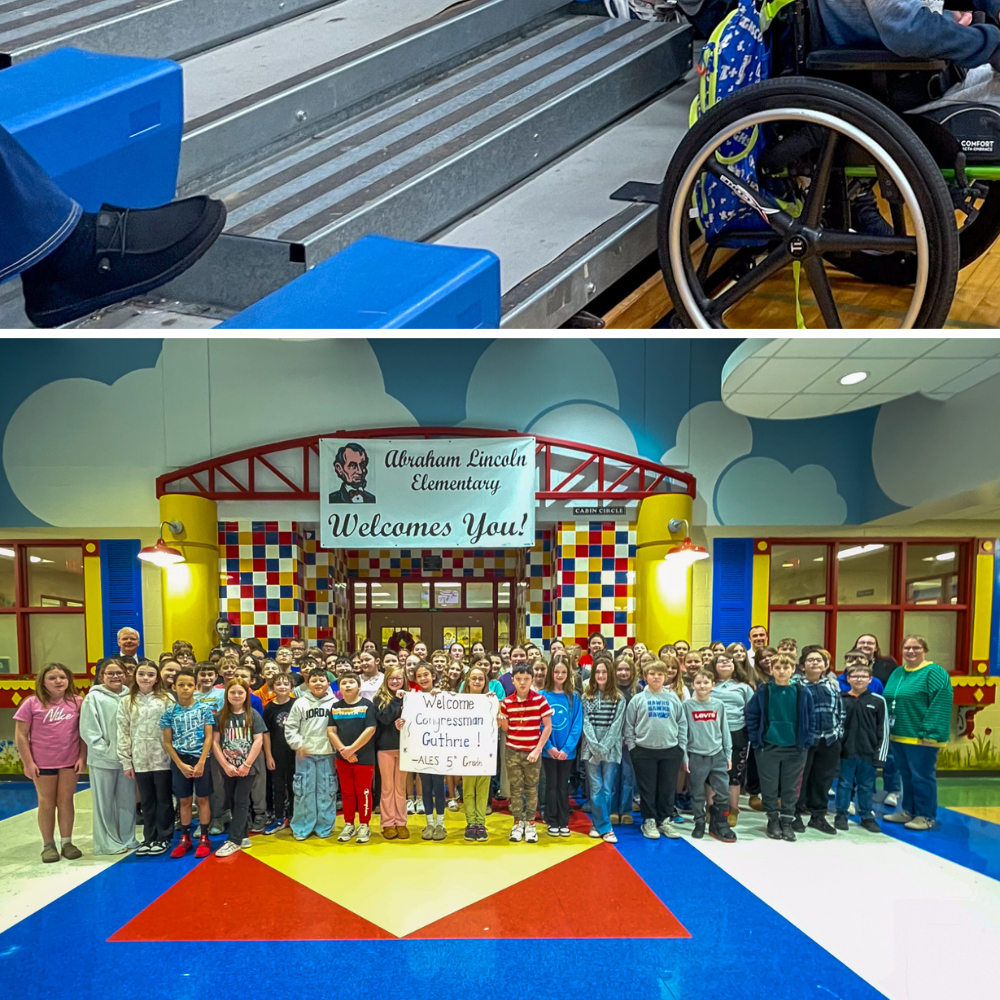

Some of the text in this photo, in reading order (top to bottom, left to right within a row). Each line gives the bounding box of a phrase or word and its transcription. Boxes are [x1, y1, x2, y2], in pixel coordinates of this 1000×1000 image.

[385, 447, 527, 468] Abraham Lincoln
[411, 473, 502, 495] Elementary
[328, 512, 528, 544] Welcomes You!
[422, 695, 475, 710] Welcome
[42, 706, 75, 724] Nike
[305, 707, 330, 720] JORDA
[422, 731, 470, 748] Guthrie
